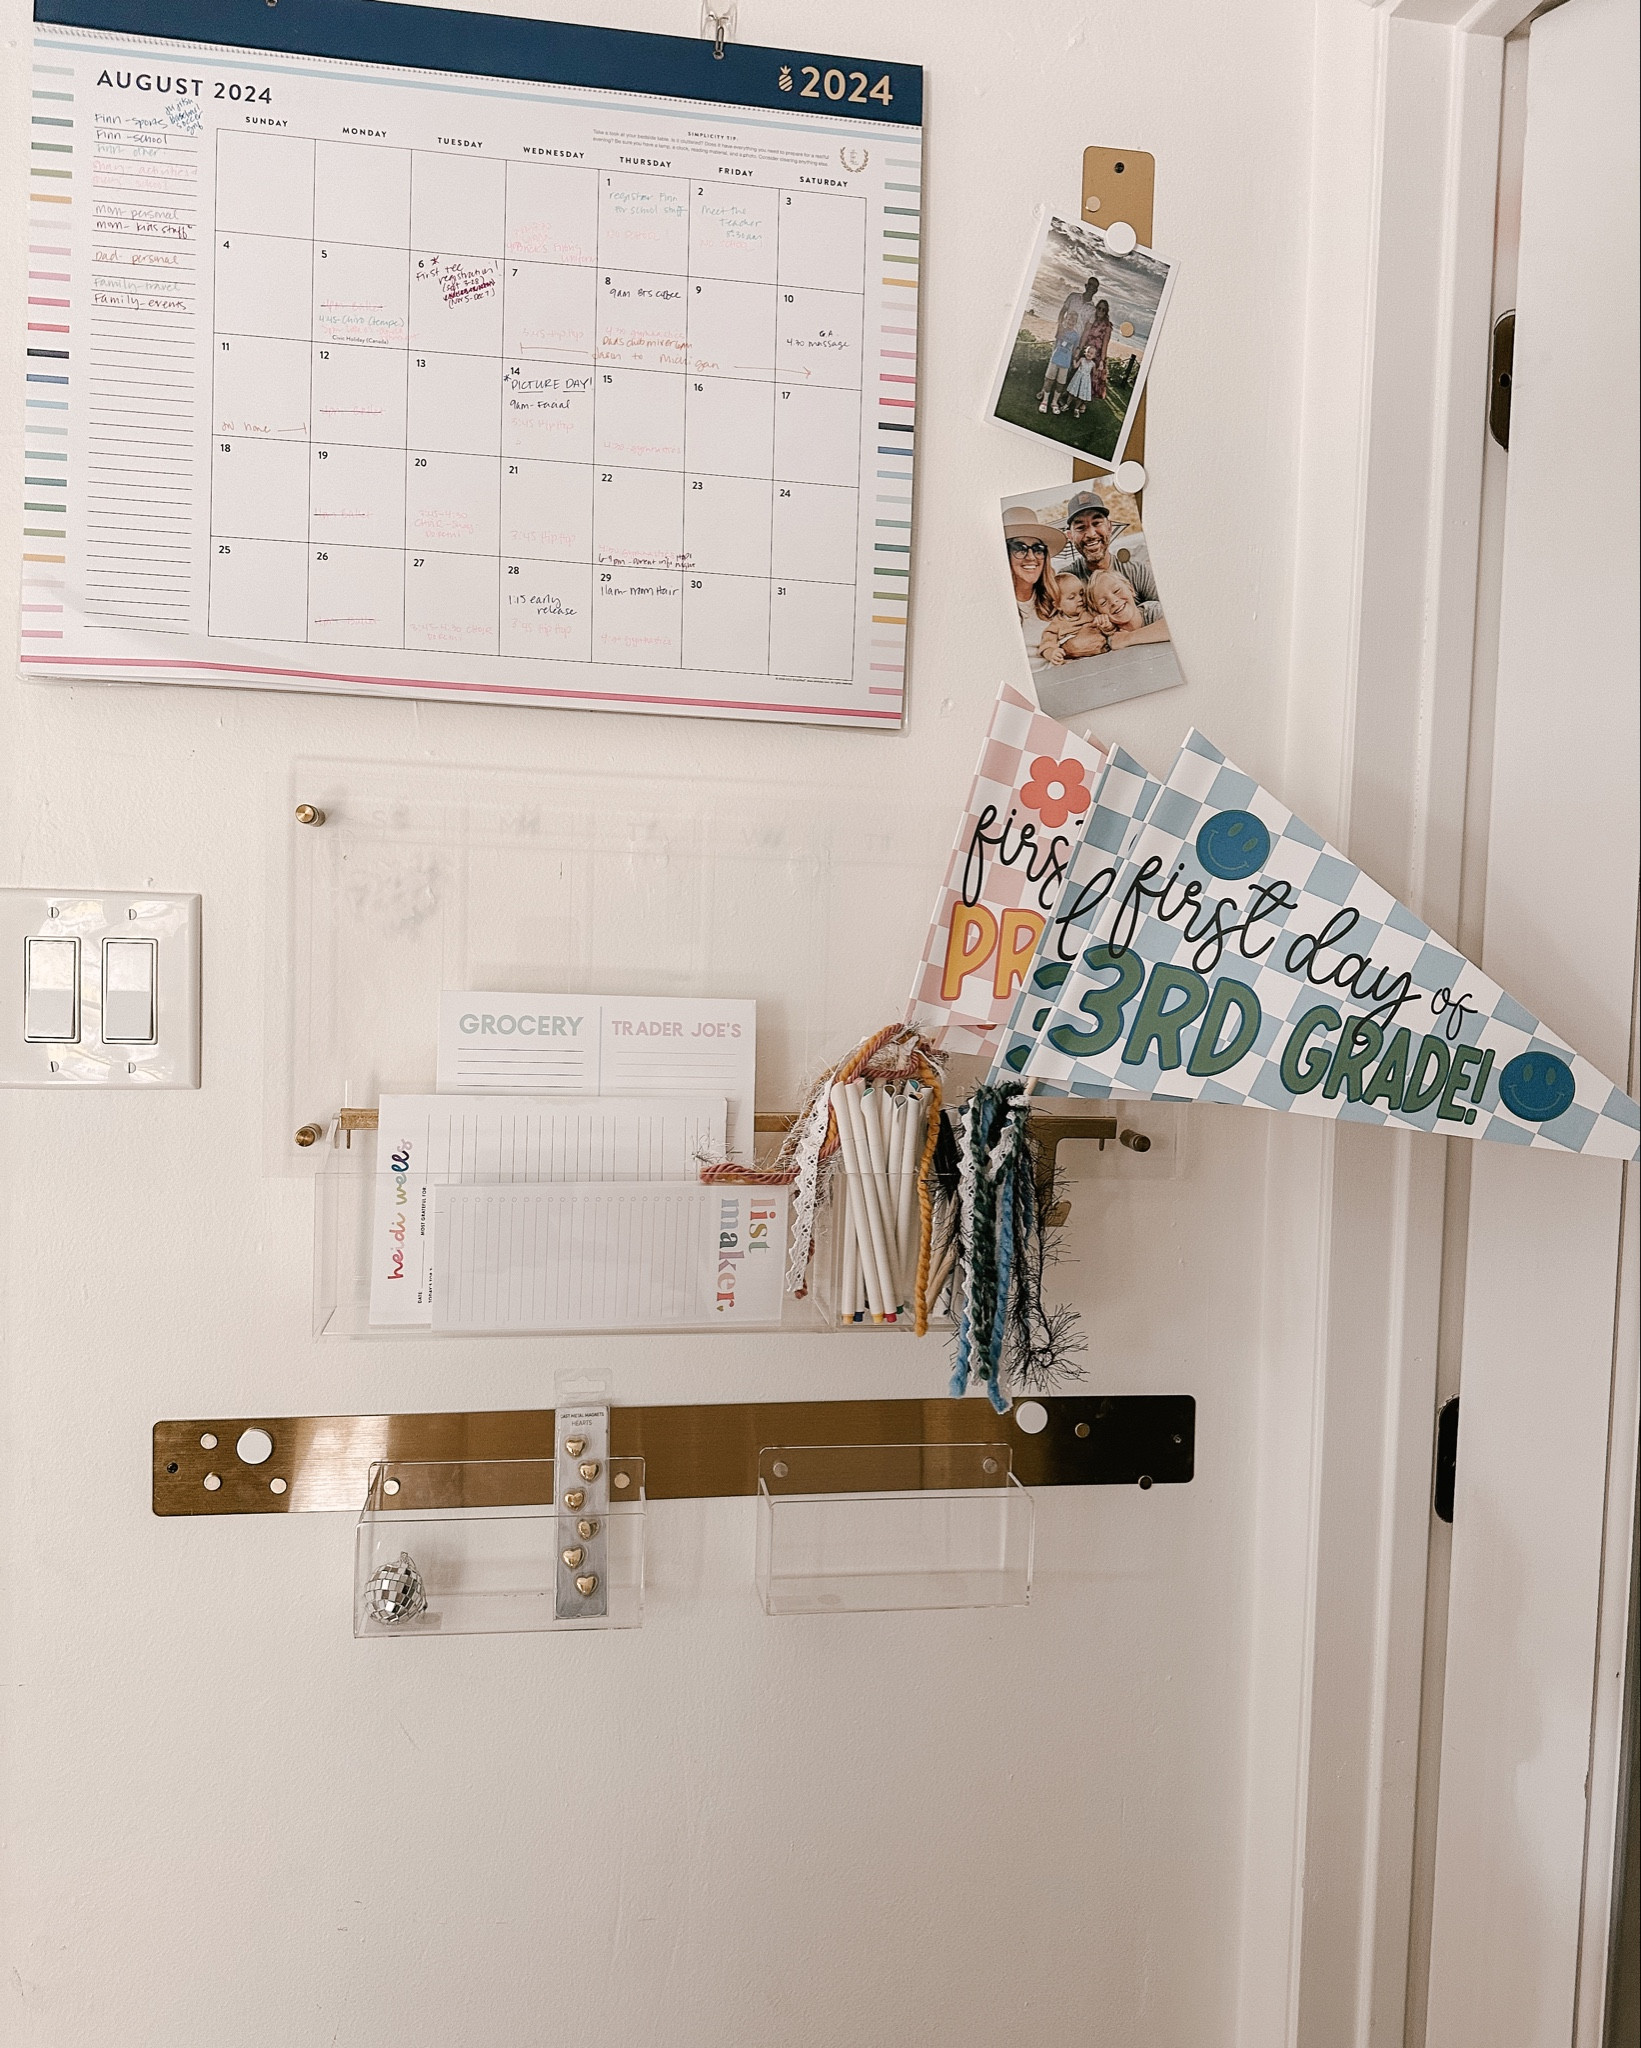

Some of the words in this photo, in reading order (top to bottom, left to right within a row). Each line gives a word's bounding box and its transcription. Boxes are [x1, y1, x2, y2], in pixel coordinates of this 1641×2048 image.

[96, 69, 203, 97] AUGUST
[213, 82, 272, 104] 2024
[800, 65, 894, 106] 2024
[687, 131, 724, 140] SIMPLICITY
[245, 116, 289, 127] SUNDAY
[342, 127, 387, 138] MONDAY
[437, 137, 483, 148] TUESDAY
[523, 146, 585, 159] WEDNESDAY
[619, 156, 672, 168] THURSDAY
[718, 167, 754, 177] FRIDAY
[799, 176, 849, 187] SATURDAY
[606, 178, 612, 186] 1
[698, 188, 704, 196] 2
[786, 197, 792, 206] 3
[222, 240, 230, 249] 4
[321, 250, 328, 258] 5
[418, 260, 424, 268] 6
[512, 268, 518, 276] 7
[605, 276, 611, 286] 8
[696, 285, 702, 294] 9
[784, 294, 794, 303] 10
[346, 335, 366, 344] Holiday
[221, 342, 230, 351] 11
[320, 351, 330, 360] 12
[416, 359, 426, 368] 13
[510, 367, 520, 376] 14
[511, 378, 560, 390] PICTURE
[603, 375, 613, 384] 15
[694, 383, 704, 392] 16
[782, 391, 791, 400] 17
[220, 444, 231, 453] 18
[318, 451, 328, 460] 19
[414, 458, 427, 467] 20
[508, 466, 518, 474] 21
[601, 474, 613, 482] 22
[692, 482, 703, 490] 23
[780, 488, 791, 498] 24
[218, 545, 231, 554] 25
[316, 552, 328, 561] 26
[414, 558, 424, 567] 27
[508, 566, 520, 575] 28
[600, 573, 612, 582] 29
[690, 580, 703, 589] 30
[777, 587, 786, 596] 31
[962, 804, 1070, 910] firs
[1108, 855, 1299, 974] first
[1285, 907, 1422, 1046] day
[1430, 986, 1479, 1041] of
[458, 1013, 584, 1036] GROCERY
[611, 1020, 683, 1037] TRADER
[690, 1022, 742, 1039] JOE'S
[1047, 943, 1264, 1078] 3RD
[1279, 1003, 1496, 1126] GRADE!
[748, 1198, 777, 1254] list
[387, 1212, 407, 1280] heidi
[716, 1198, 745, 1308] maker
